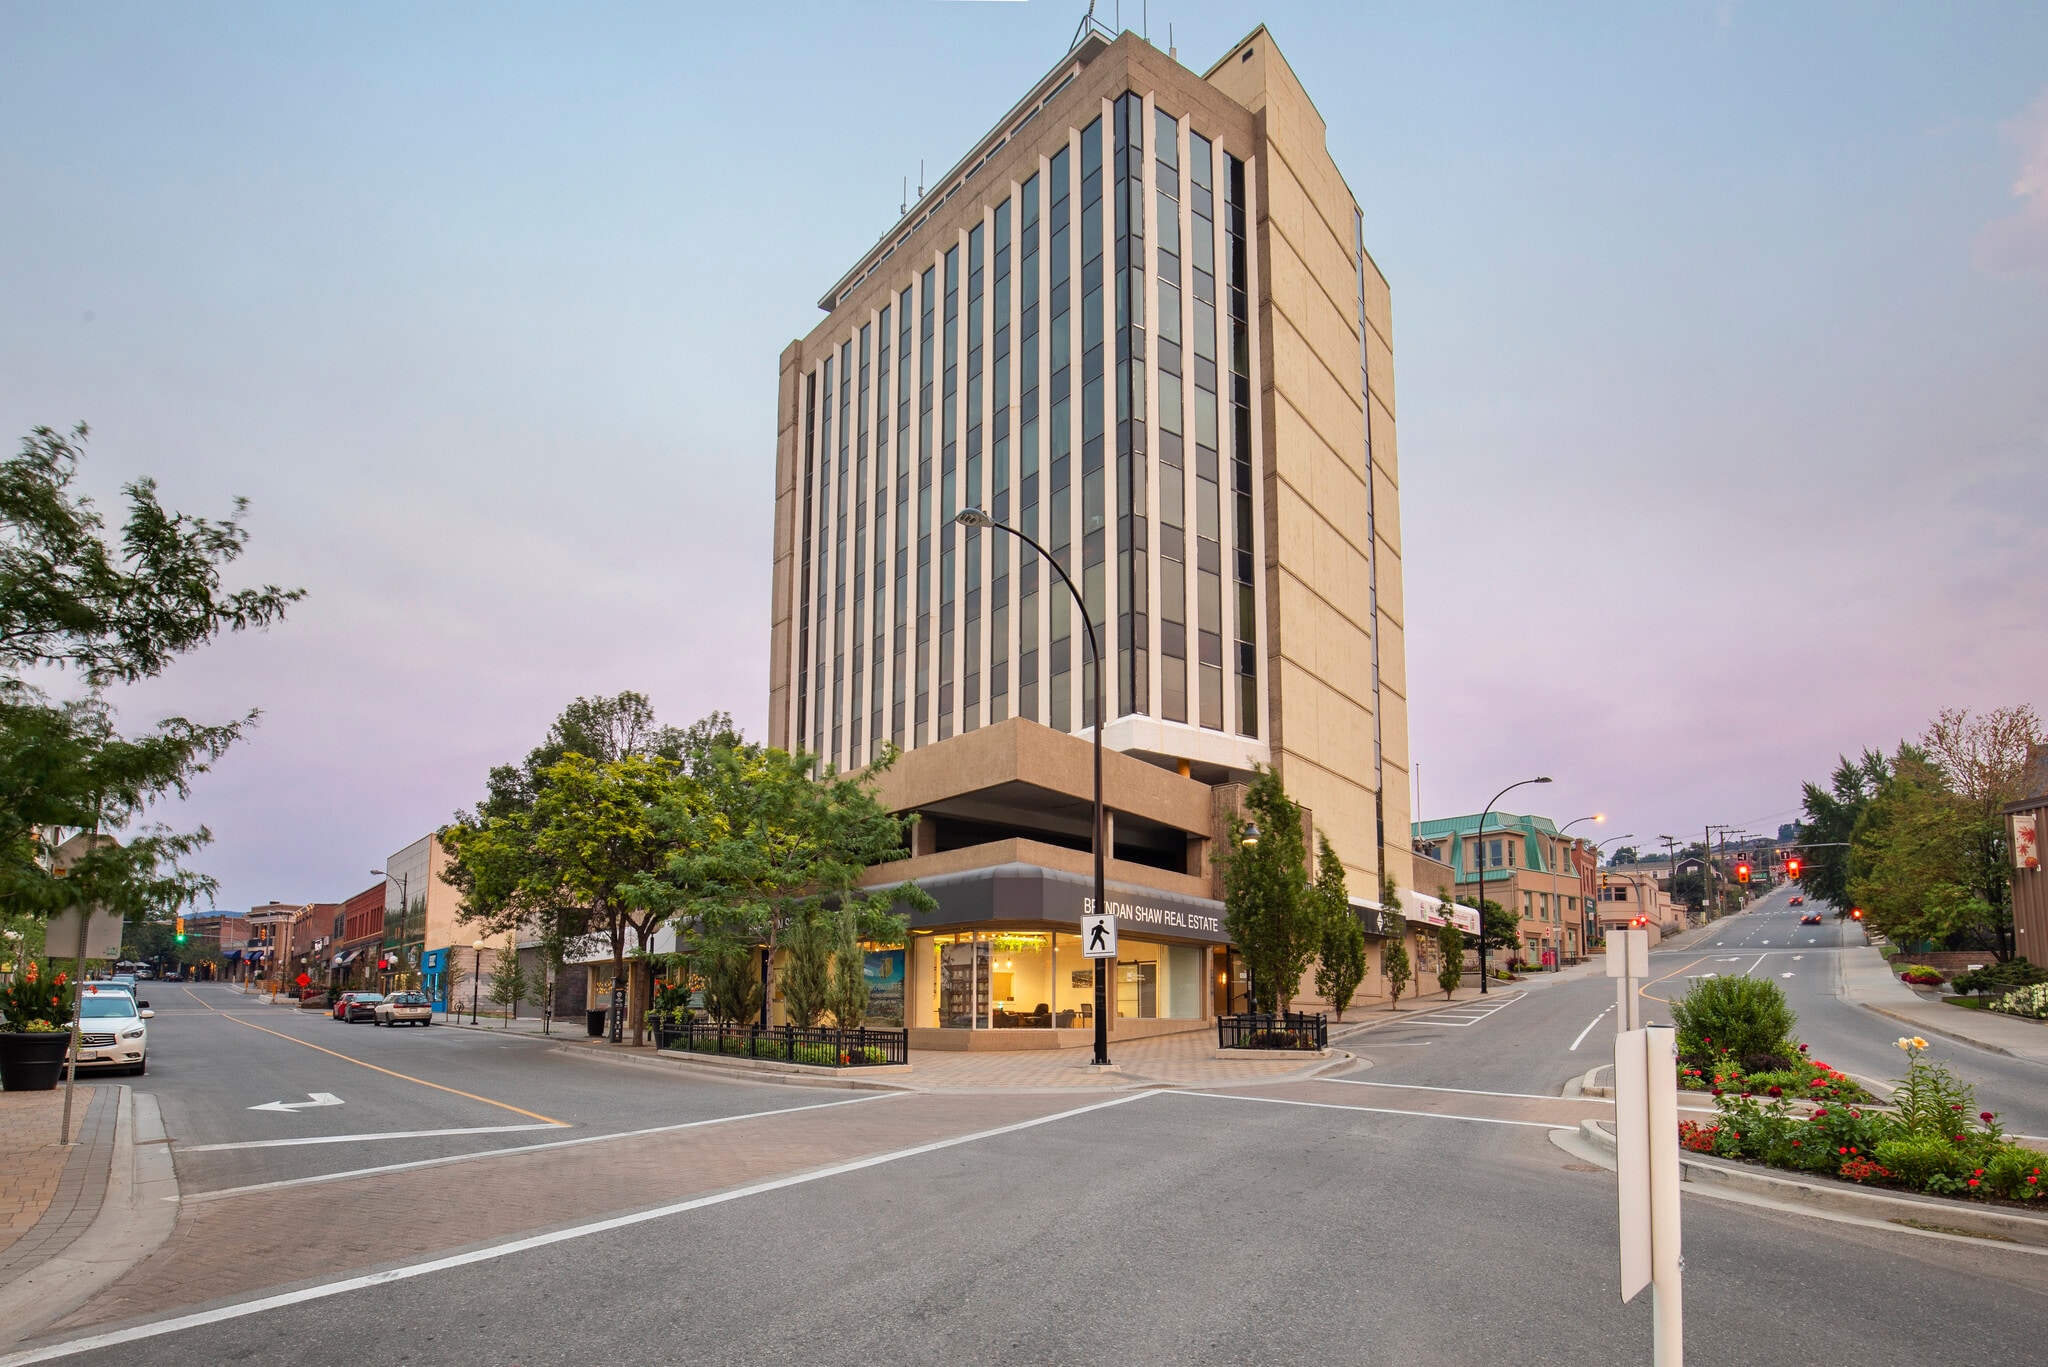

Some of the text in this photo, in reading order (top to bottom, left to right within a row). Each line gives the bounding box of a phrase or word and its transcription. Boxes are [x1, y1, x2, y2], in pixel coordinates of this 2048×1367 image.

[1135, 906, 1163, 925] SHAW
[1164, 910, 1187, 928] REAL
[1188, 914, 1219, 932] ESTATE
